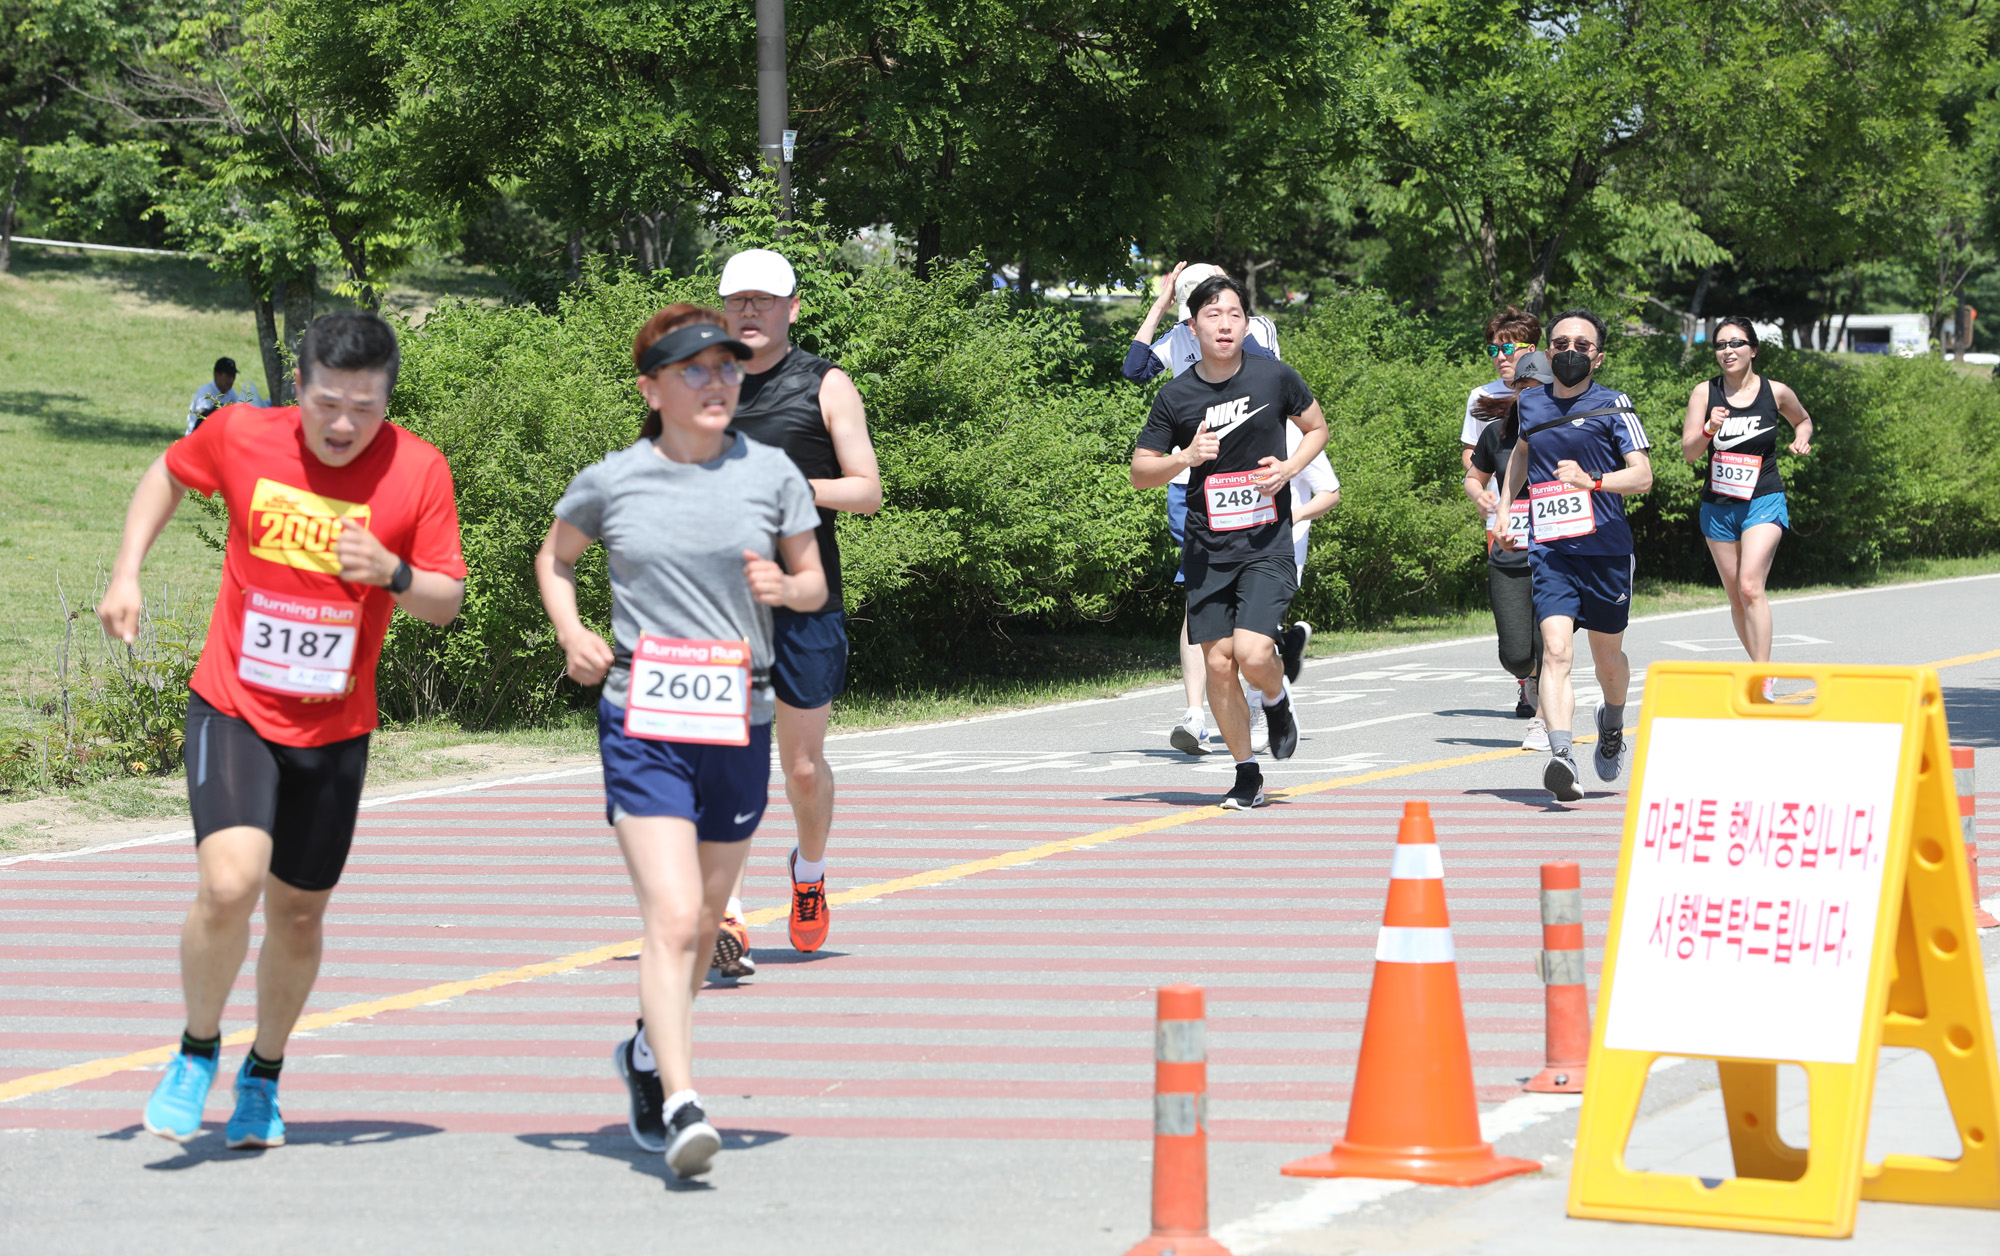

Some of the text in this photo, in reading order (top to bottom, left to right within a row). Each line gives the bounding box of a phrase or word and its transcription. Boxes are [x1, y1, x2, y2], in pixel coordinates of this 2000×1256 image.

[1205, 396, 1250, 429] NIKE
[1719, 416, 1761, 437] NIKE
[1714, 452, 1742, 463] Burning
[1209, 475, 1247, 484] Burning
[1716, 465, 1754, 482] 3037
[1532, 484, 1562, 494] Burning
[1537, 496, 1582, 519] 2483
[252, 592, 354, 620] Burning Run
[254, 622, 342, 659] 3187
[642, 640, 744, 662] Burning Run
[645, 670, 733, 702] 2602
[1644, 797, 1878, 871] 마라톤 행사중입니다.
[1649, 893, 1852, 967] 서행부탁드립니다.
